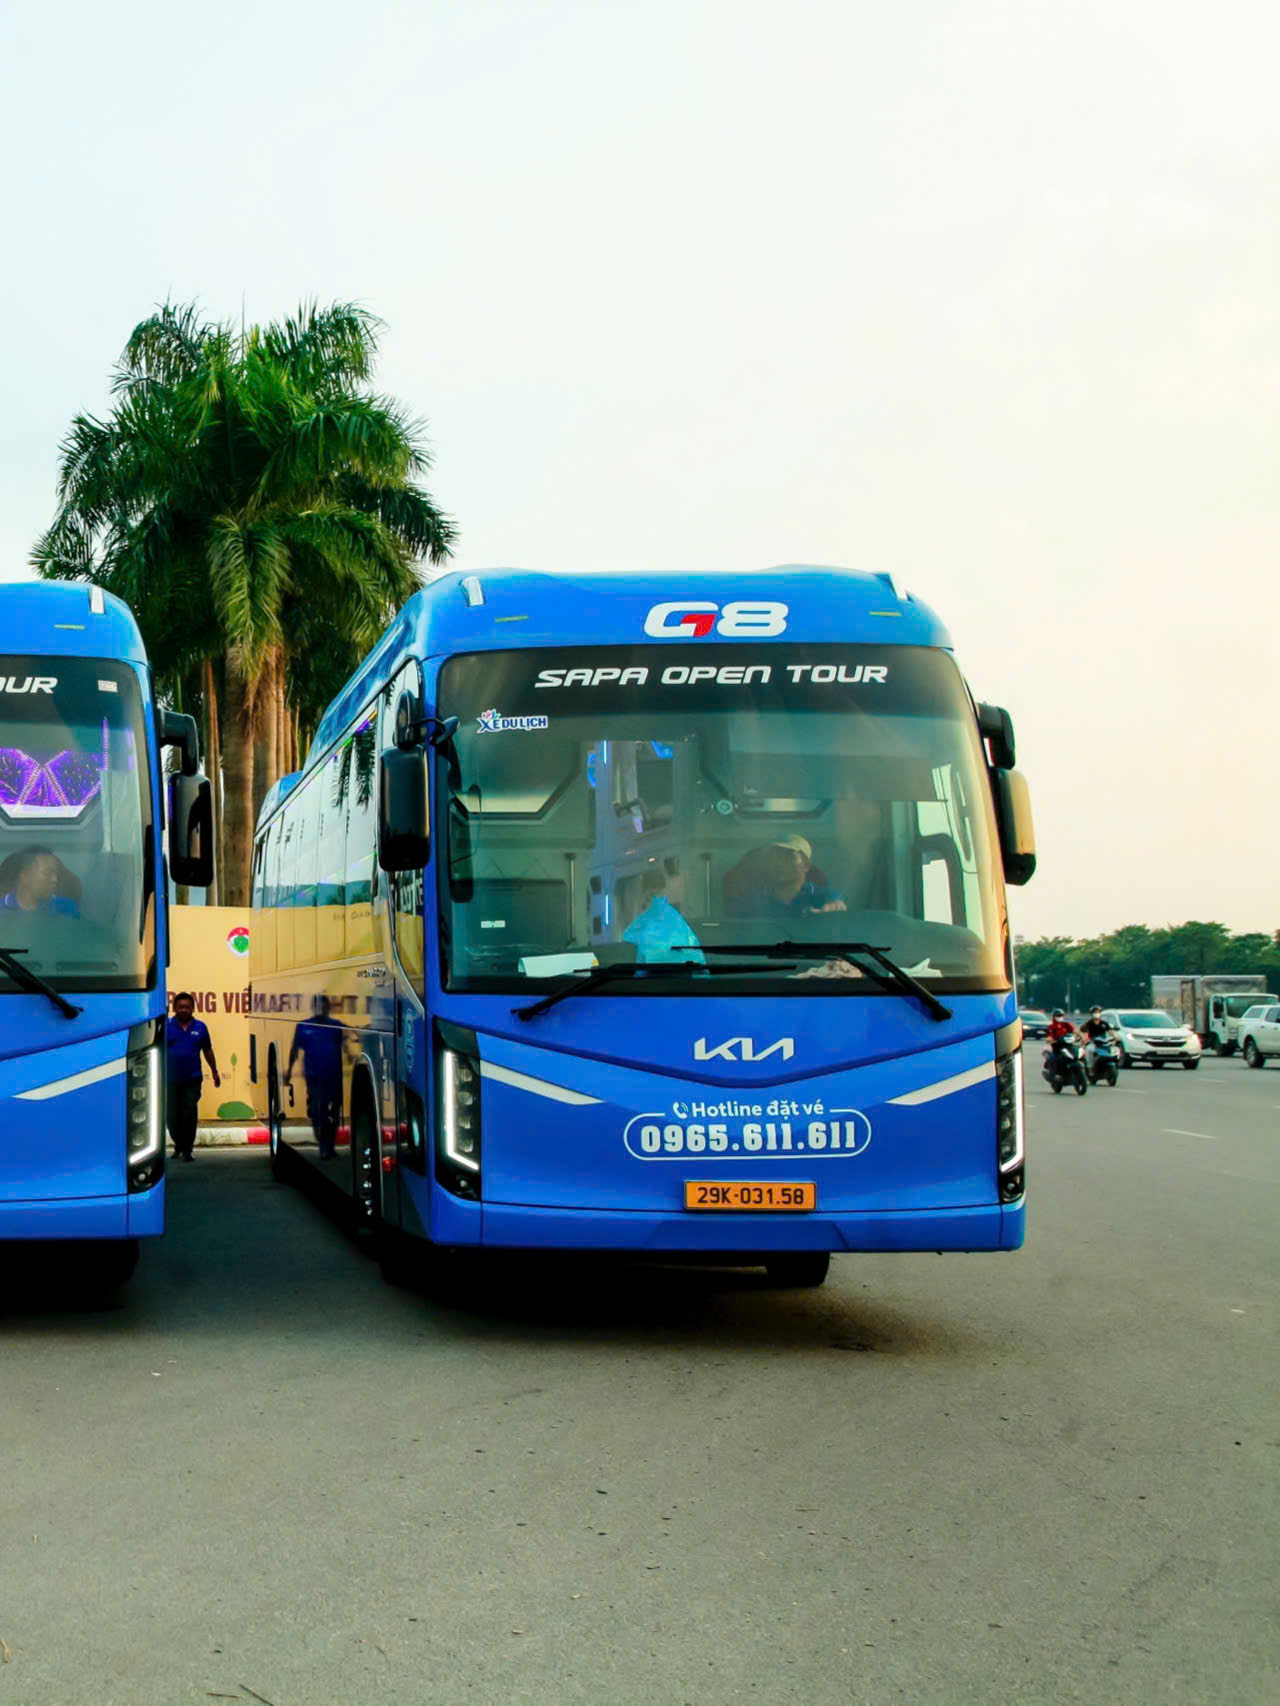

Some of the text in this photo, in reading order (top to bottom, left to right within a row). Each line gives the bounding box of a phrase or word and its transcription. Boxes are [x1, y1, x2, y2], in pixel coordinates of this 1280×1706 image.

[644, 601, 790, 638] G8
[534, 664, 888, 688] SAPA OPEN TOUR
[477, 717, 500, 733] XE
[501, 718, 518, 729] DU
[694, 1037, 794, 1061] KIA
[691, 1098, 824, 1121] Hotline đặt vé
[640, 1121, 856, 1153] 0965.611.611
[697, 1187, 805, 1205] 29K-031.58
